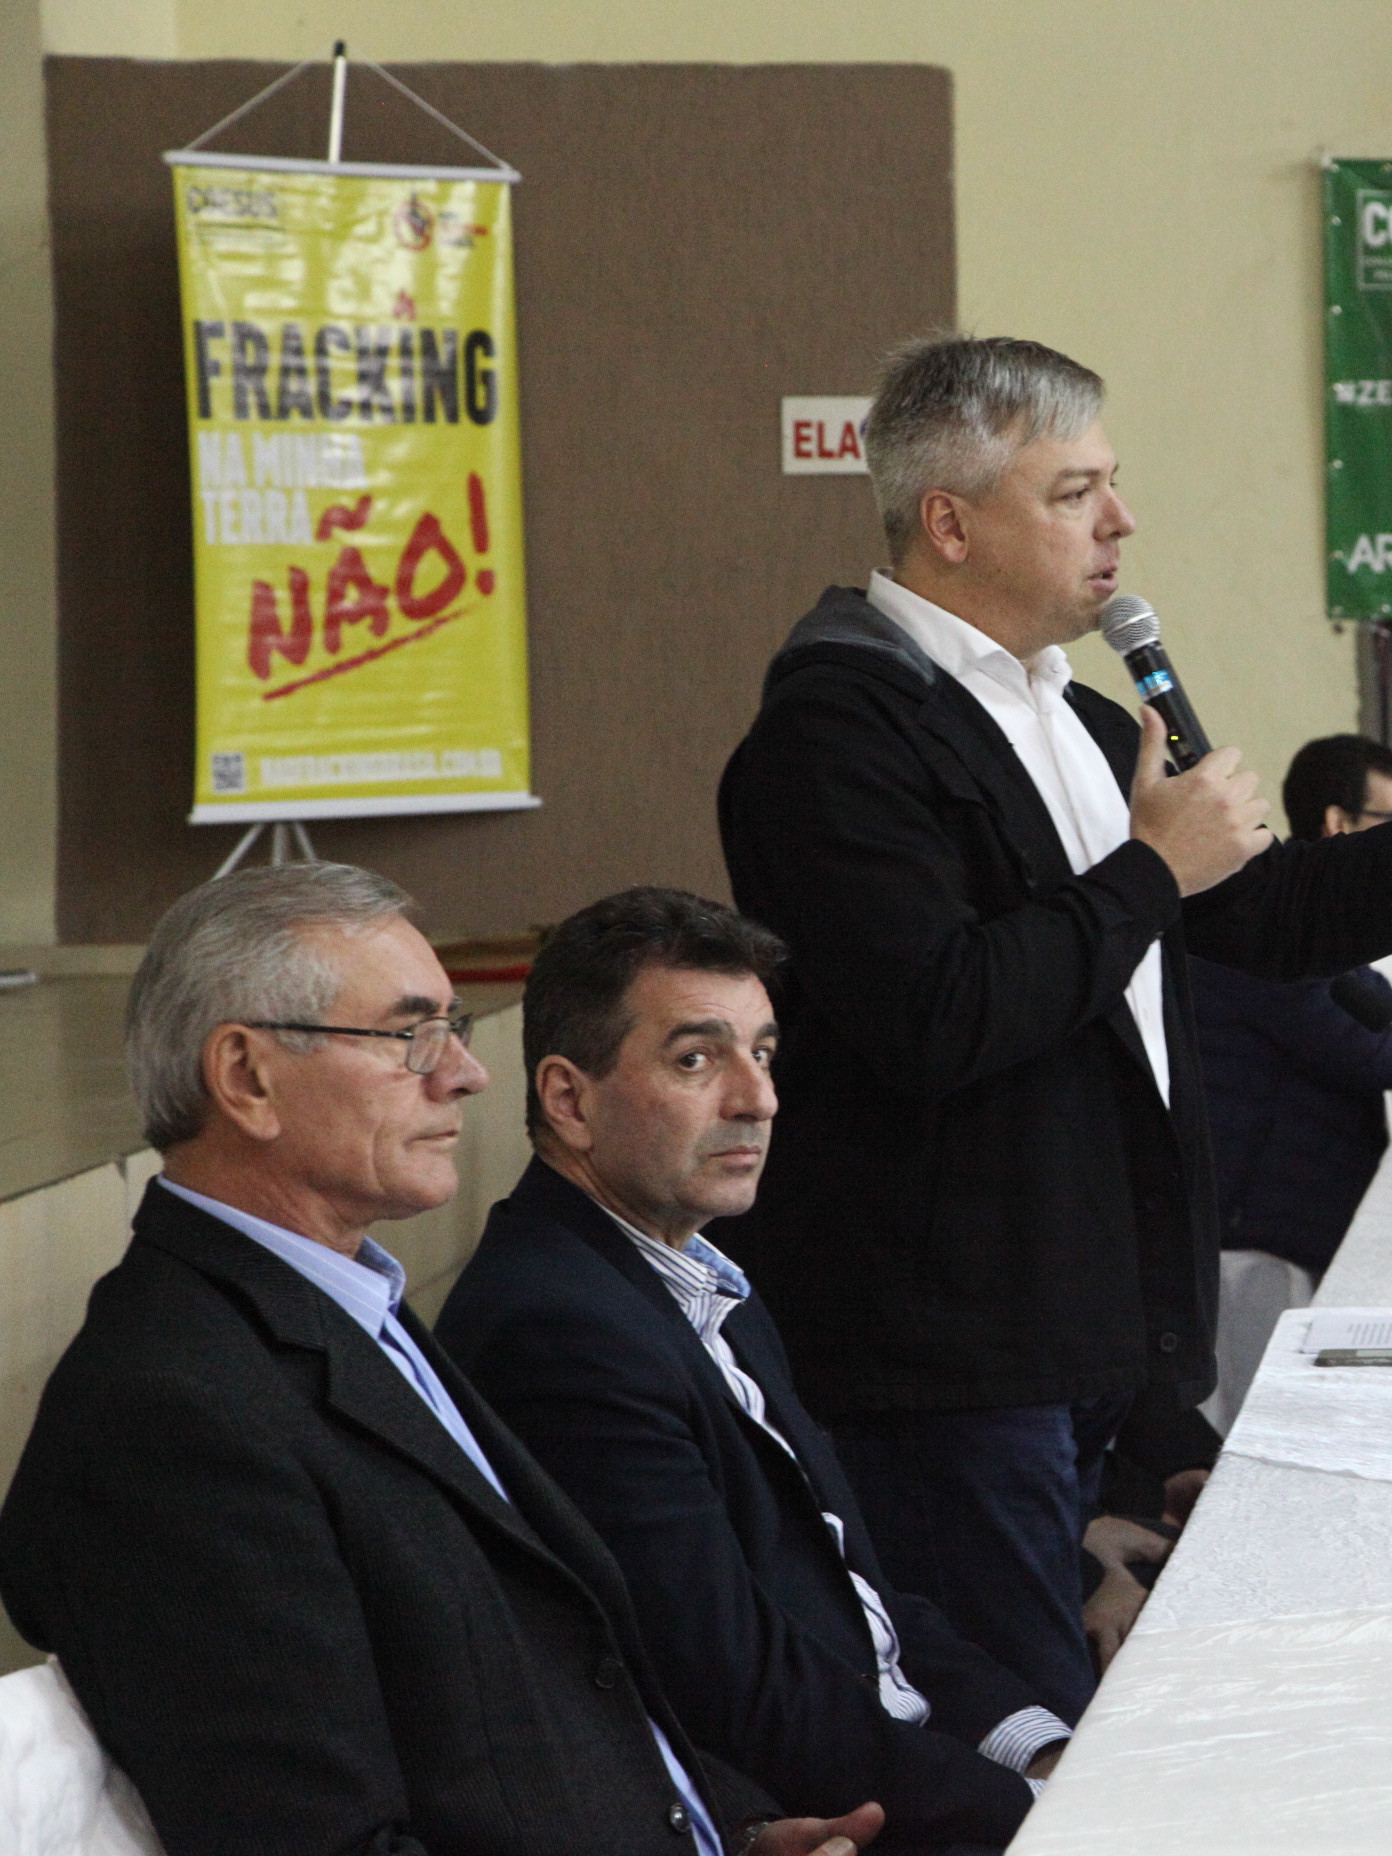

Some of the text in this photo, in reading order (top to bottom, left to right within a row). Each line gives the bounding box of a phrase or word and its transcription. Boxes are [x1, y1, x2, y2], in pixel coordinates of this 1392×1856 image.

[193, 320, 497, 427] FRACKING
[202, 489, 313, 545] TERRA
[247, 470, 495, 681] NÃO!
